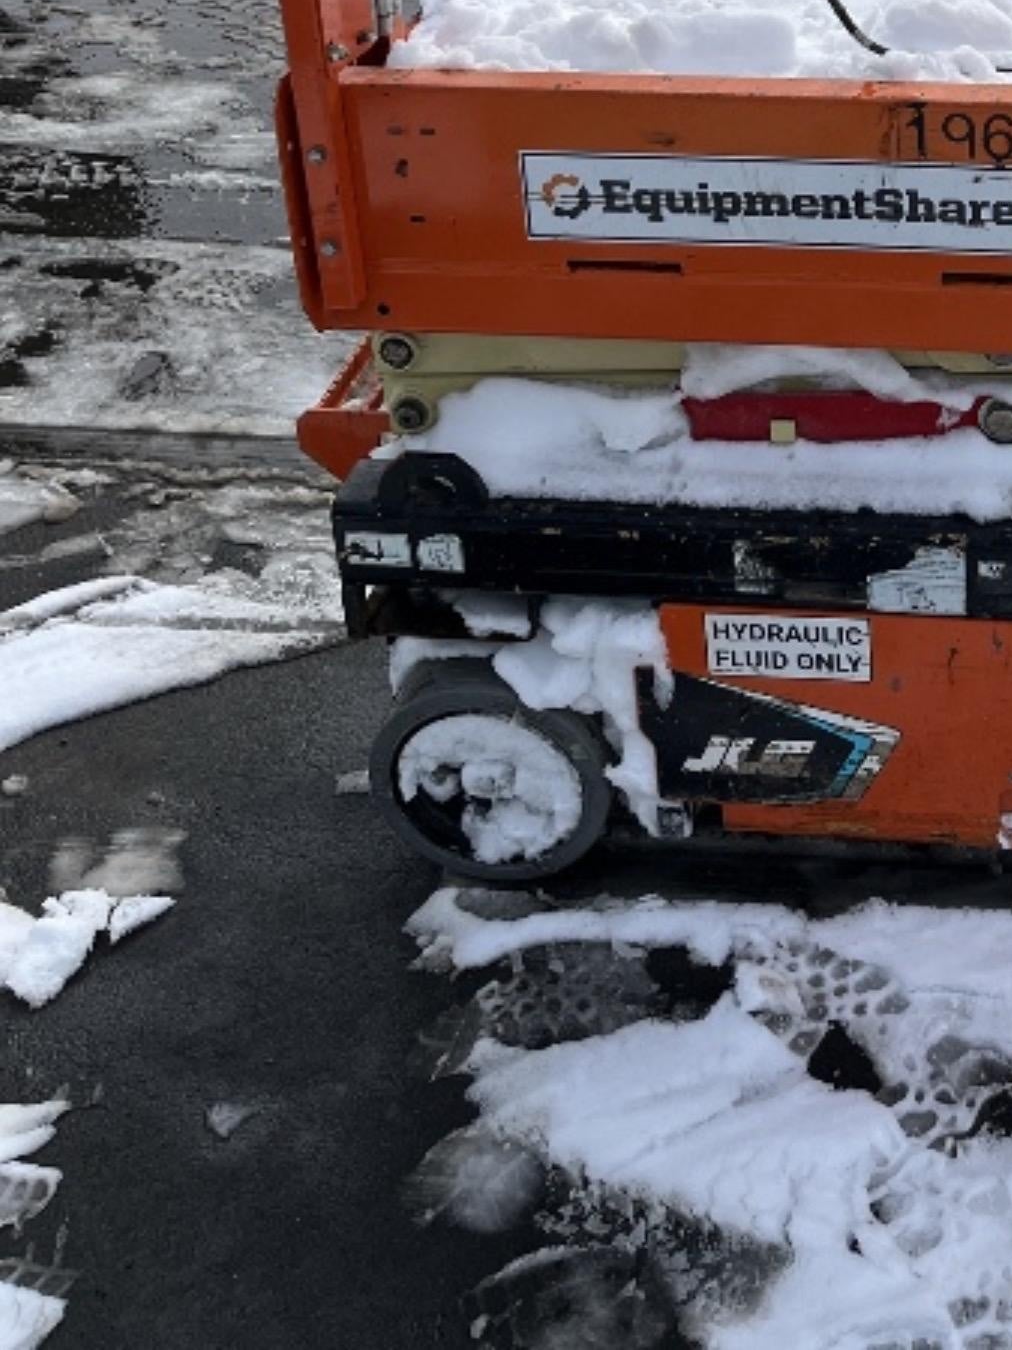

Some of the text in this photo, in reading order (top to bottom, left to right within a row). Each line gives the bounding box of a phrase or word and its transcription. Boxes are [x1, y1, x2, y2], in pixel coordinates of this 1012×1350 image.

[712, 621, 863, 646] HYDRAULIC
[715, 650, 862, 673] FLUID ONLY
